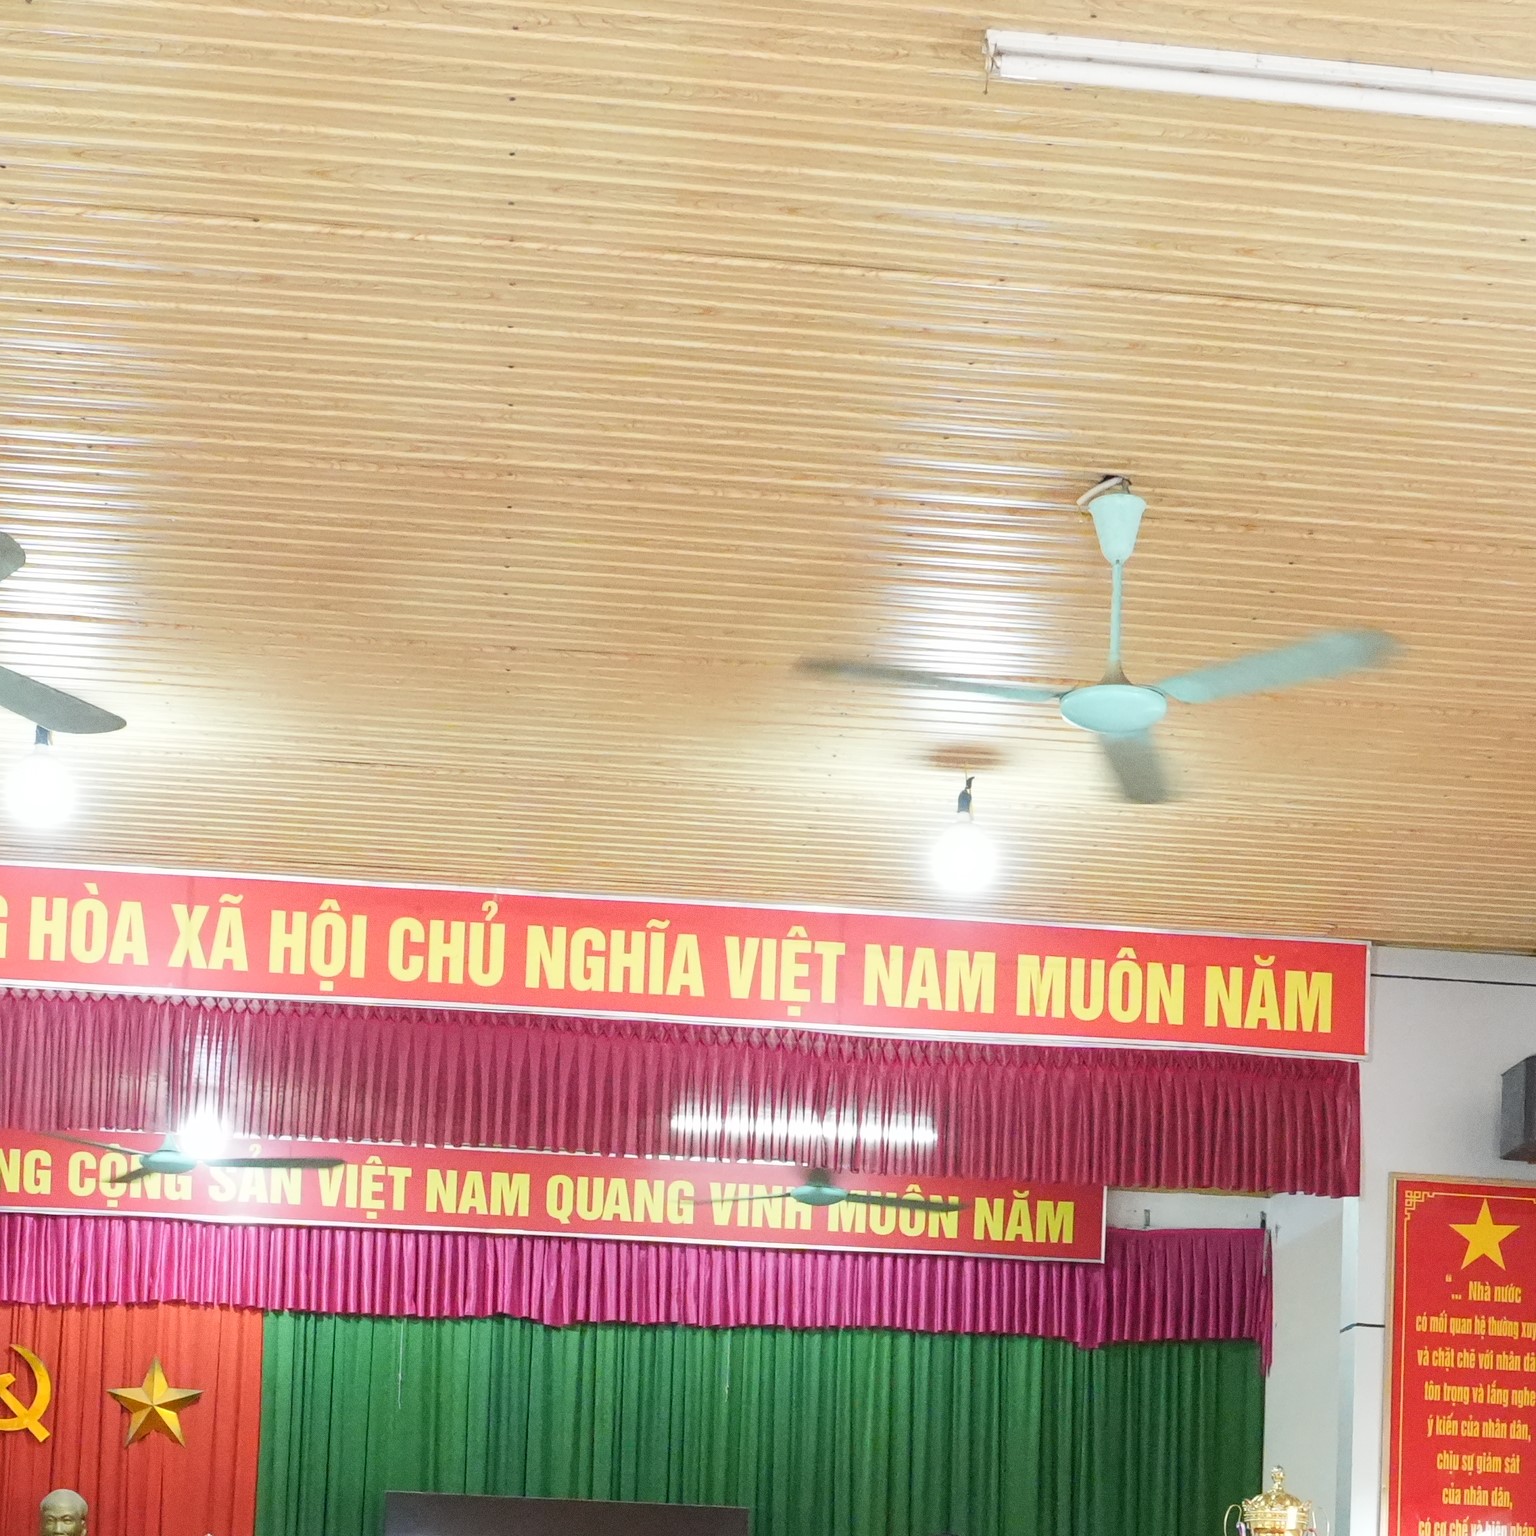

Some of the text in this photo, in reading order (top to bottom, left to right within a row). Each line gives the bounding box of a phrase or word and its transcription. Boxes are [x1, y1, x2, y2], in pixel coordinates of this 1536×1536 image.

[30, 883, 149, 966] HÒA
[171, 893, 249, 972] XÃ
[270, 899, 367, 992] HỘI
[389, 901, 505, 987] CHỦ
[526, 919, 705, 998] NGHĨA
[726, 926, 846, 1016] VIỆT
[864, 945, 999, 1014] NAM
[1016, 946, 1186, 1027] MUÔN
[1206, 955, 1334, 1033] NĂM
[318, 1155, 412, 1219] VIỆT
[426, 1168, 531, 1217] NAM
[546, 1174, 695, 1225] QUANG
[710, 1182, 812, 1230] VINH
[827, 1184, 960, 1239] MUÔN
[973, 1189, 1075, 1244] NĂM
[1468, 1281, 1522, 1303] Nhà nước
[1416, 1312, 1427, 1332] có
[1430, 1310, 1448, 1333] mối
[1450, 1317, 1472, 1336] quan
[1474, 1315, 1486, 1340] hệ
[1488, 1316, 1519, 1340] thường
[1417, 1346, 1429, 1366] và
[1432, 1347, 1454, 1372] chặt
[1457, 1348, 1476, 1369] chẽ
[1478, 1349, 1494, 1369] với
[1496, 1351, 1520, 1372] nhân
[1425, 1380, 1536, 1408] tôn trọng và lắng nghe
[1427, 1412, 1531, 1443] ý kiến của nhân dân,
[1437, 1450, 1520, 1476] chịu sự giám sát
[1442, 1482, 1513, 1510] của nhân dân,
